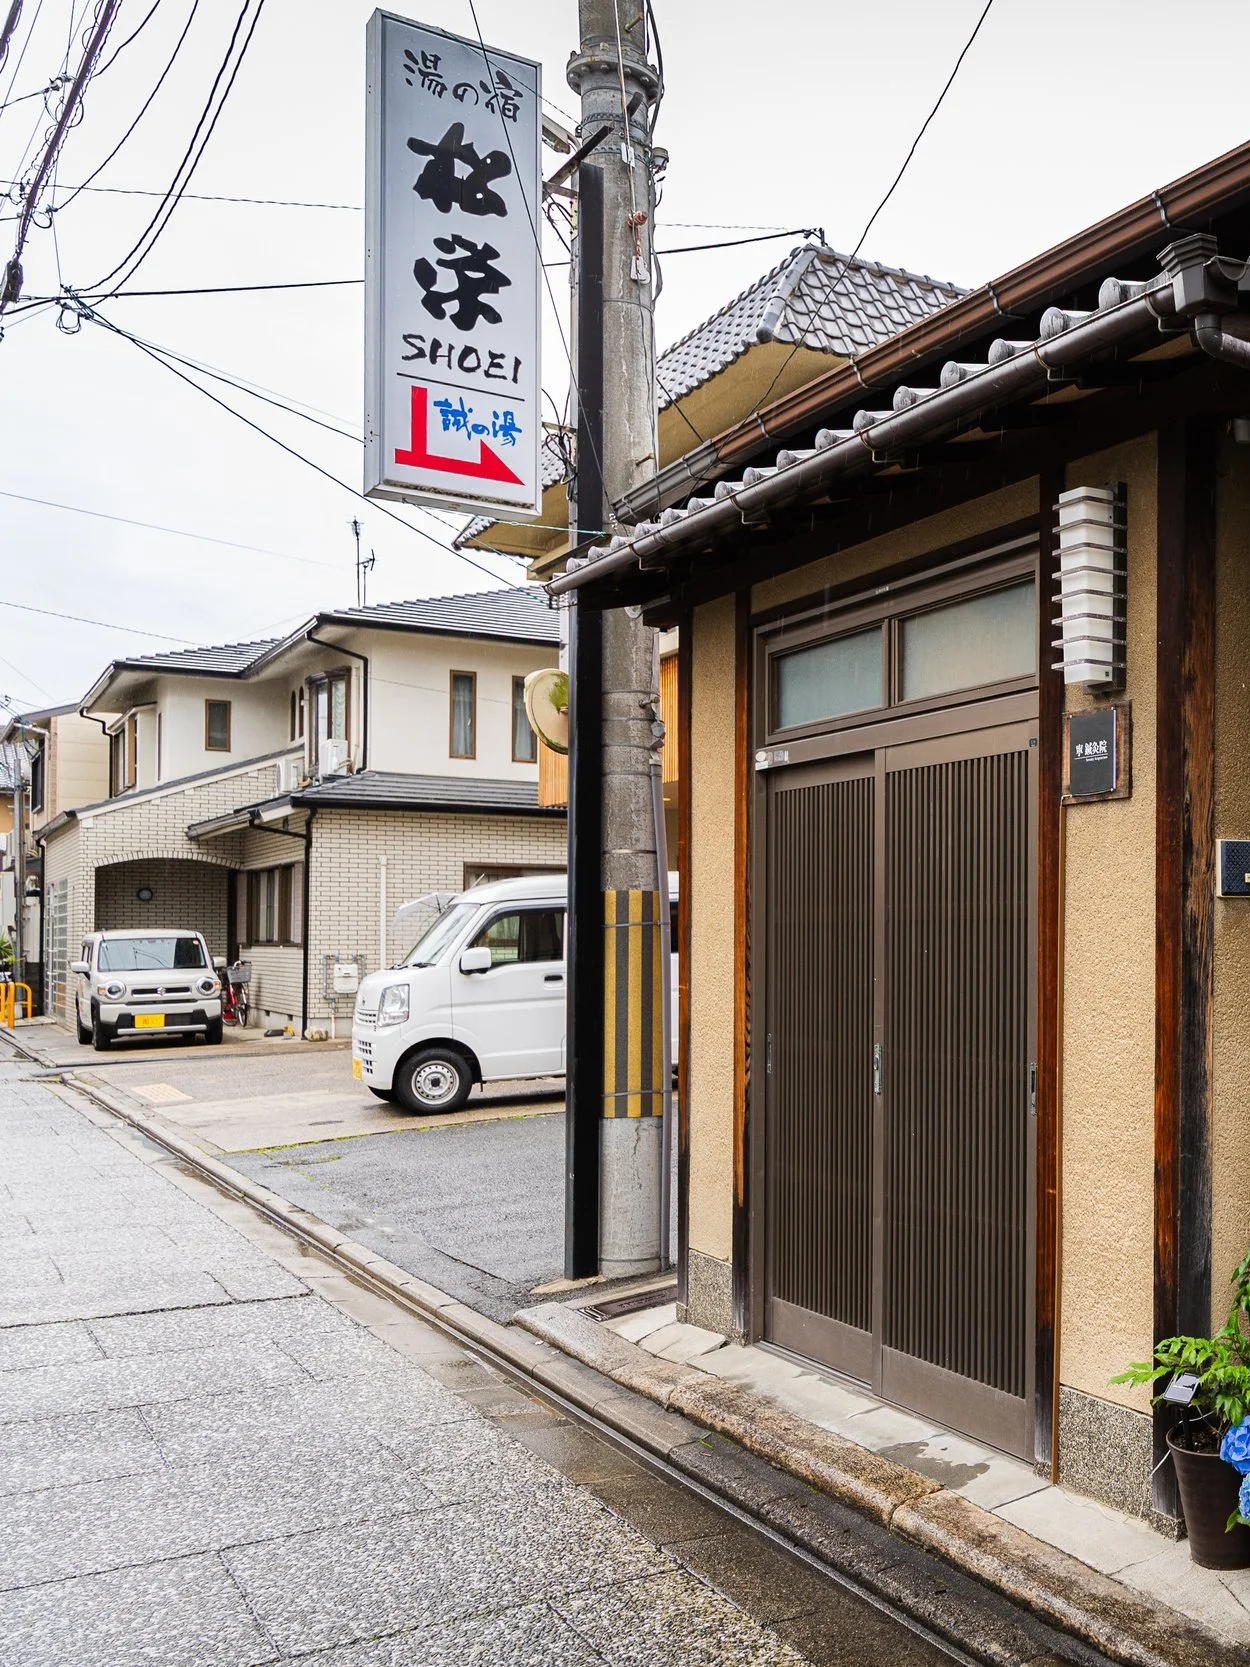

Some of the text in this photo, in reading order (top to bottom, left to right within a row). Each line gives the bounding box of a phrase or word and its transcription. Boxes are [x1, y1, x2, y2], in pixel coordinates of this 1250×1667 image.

[403, 49, 524, 122] 湯の宿
[401, 333, 523, 385] SHOEI
[433, 396, 523, 447] 誠の湯
